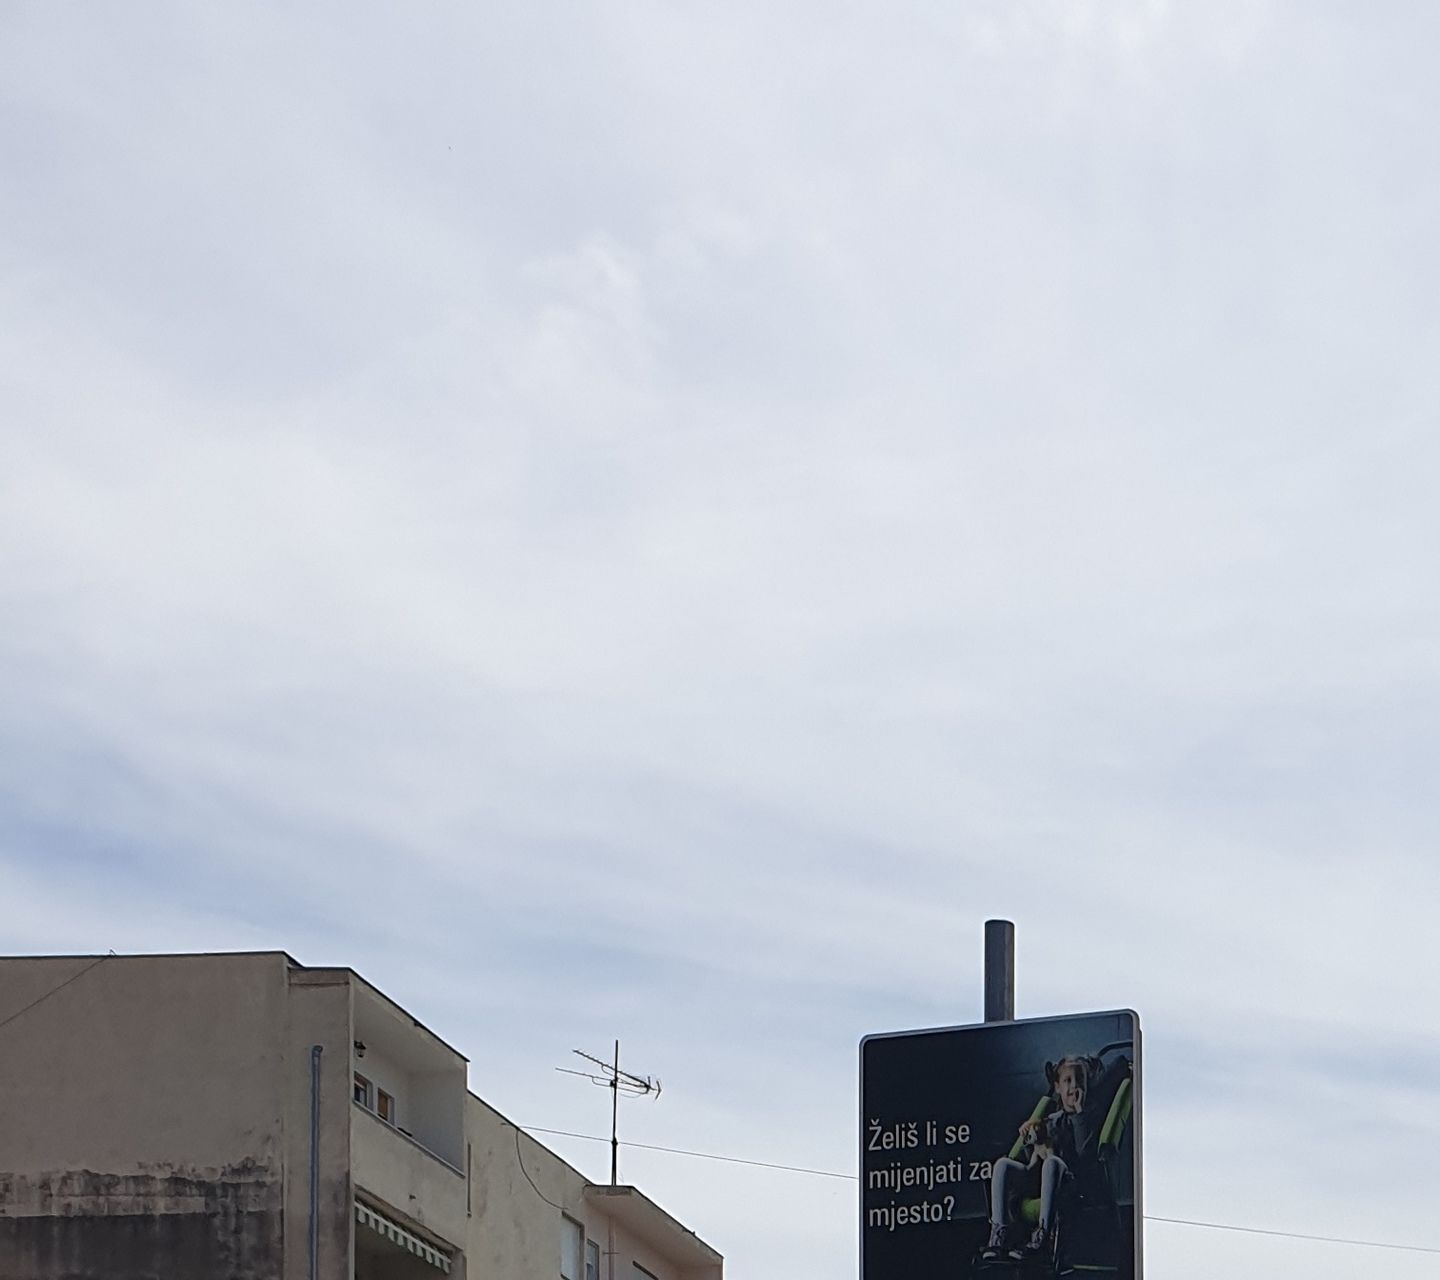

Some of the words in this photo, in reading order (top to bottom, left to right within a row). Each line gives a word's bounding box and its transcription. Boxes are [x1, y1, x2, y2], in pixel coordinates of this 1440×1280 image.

[868, 1119, 919, 1151] Želiš
[926, 1121, 937, 1147] li
[945, 1124, 970, 1144] se
[868, 1157, 962, 1193] mijenjati
[969, 1160, 992, 1181] za
[868, 1196, 955, 1231] mjesto?
